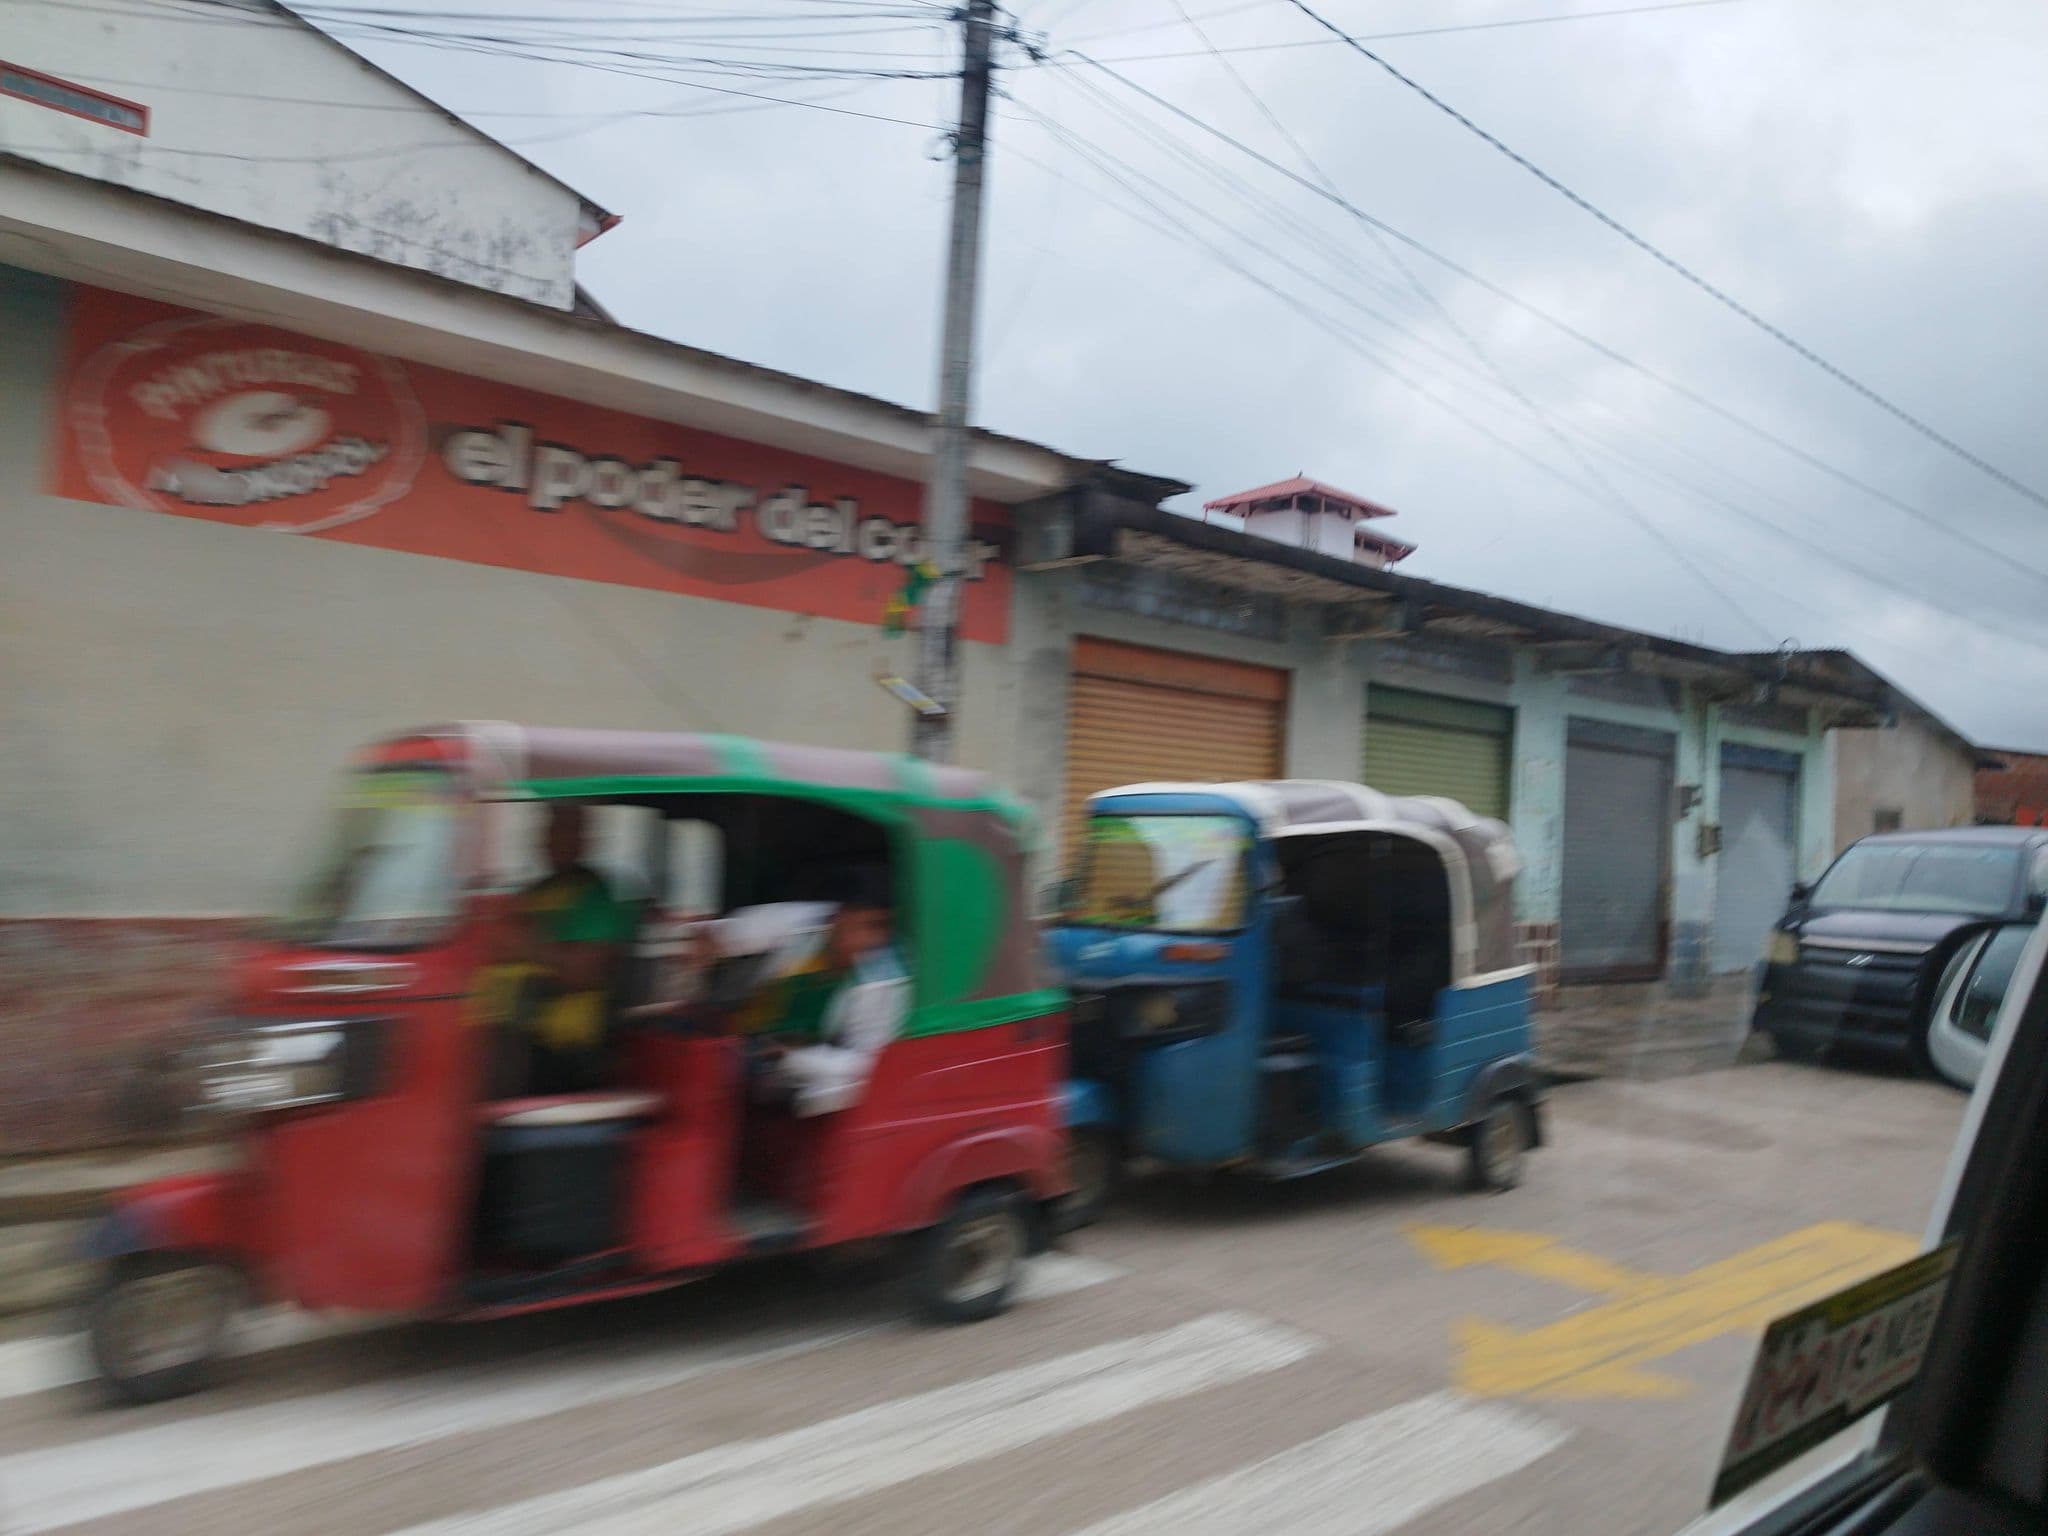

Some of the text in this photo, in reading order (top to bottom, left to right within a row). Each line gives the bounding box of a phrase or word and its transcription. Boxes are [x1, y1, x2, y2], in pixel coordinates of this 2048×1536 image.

[444, 420, 532, 492] el
[528, 440, 756, 531] poder
[756, 484, 858, 555] del
[858, 513, 1000, 580] cor
